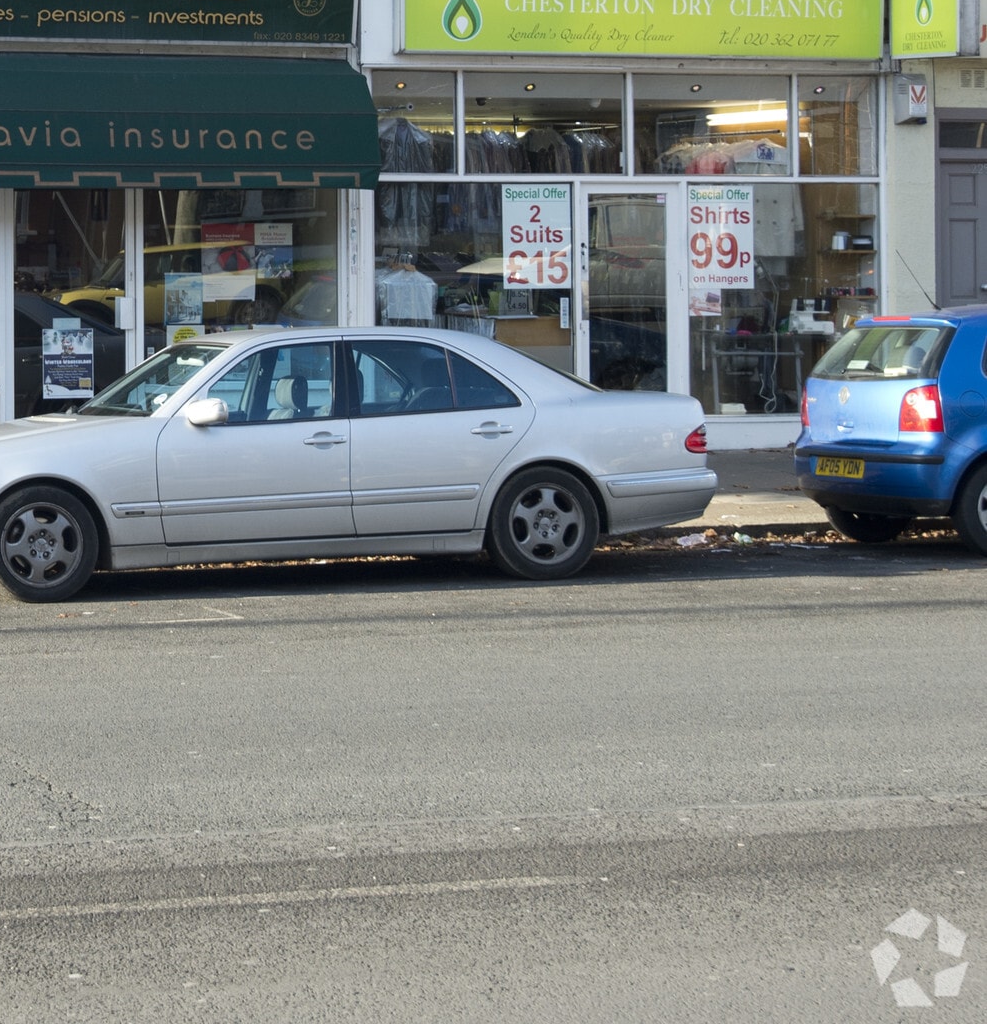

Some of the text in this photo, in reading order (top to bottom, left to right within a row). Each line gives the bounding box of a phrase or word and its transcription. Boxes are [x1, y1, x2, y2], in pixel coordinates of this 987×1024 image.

[37, 8, 126, 27] pensions
[148, 9, 264, 26] investments
[274, 32, 292, 40] 020
[295, 32, 319, 41] 8349
[324, 33, 345, 41] 1221
[507, 23, 674, 51] London's Quality Dry Cleaner
[743, 32, 768, 46] 020
[905, 30, 943, 41] CHESTERTON
[902, 40, 946, 51] DRY CLEANING
[108, 121, 315, 150] insurance
[504, 188, 567, 200] Special Offer
[690, 189, 750, 201] Special Offer
[529, 205, 541, 222] 2
[690, 206, 751, 225] Shirts
[510, 225, 564, 243] Suits
[507, 250, 569, 284] £15
[693, 274, 749, 285] on Hangers
[819, 458, 840, 473] AF05
